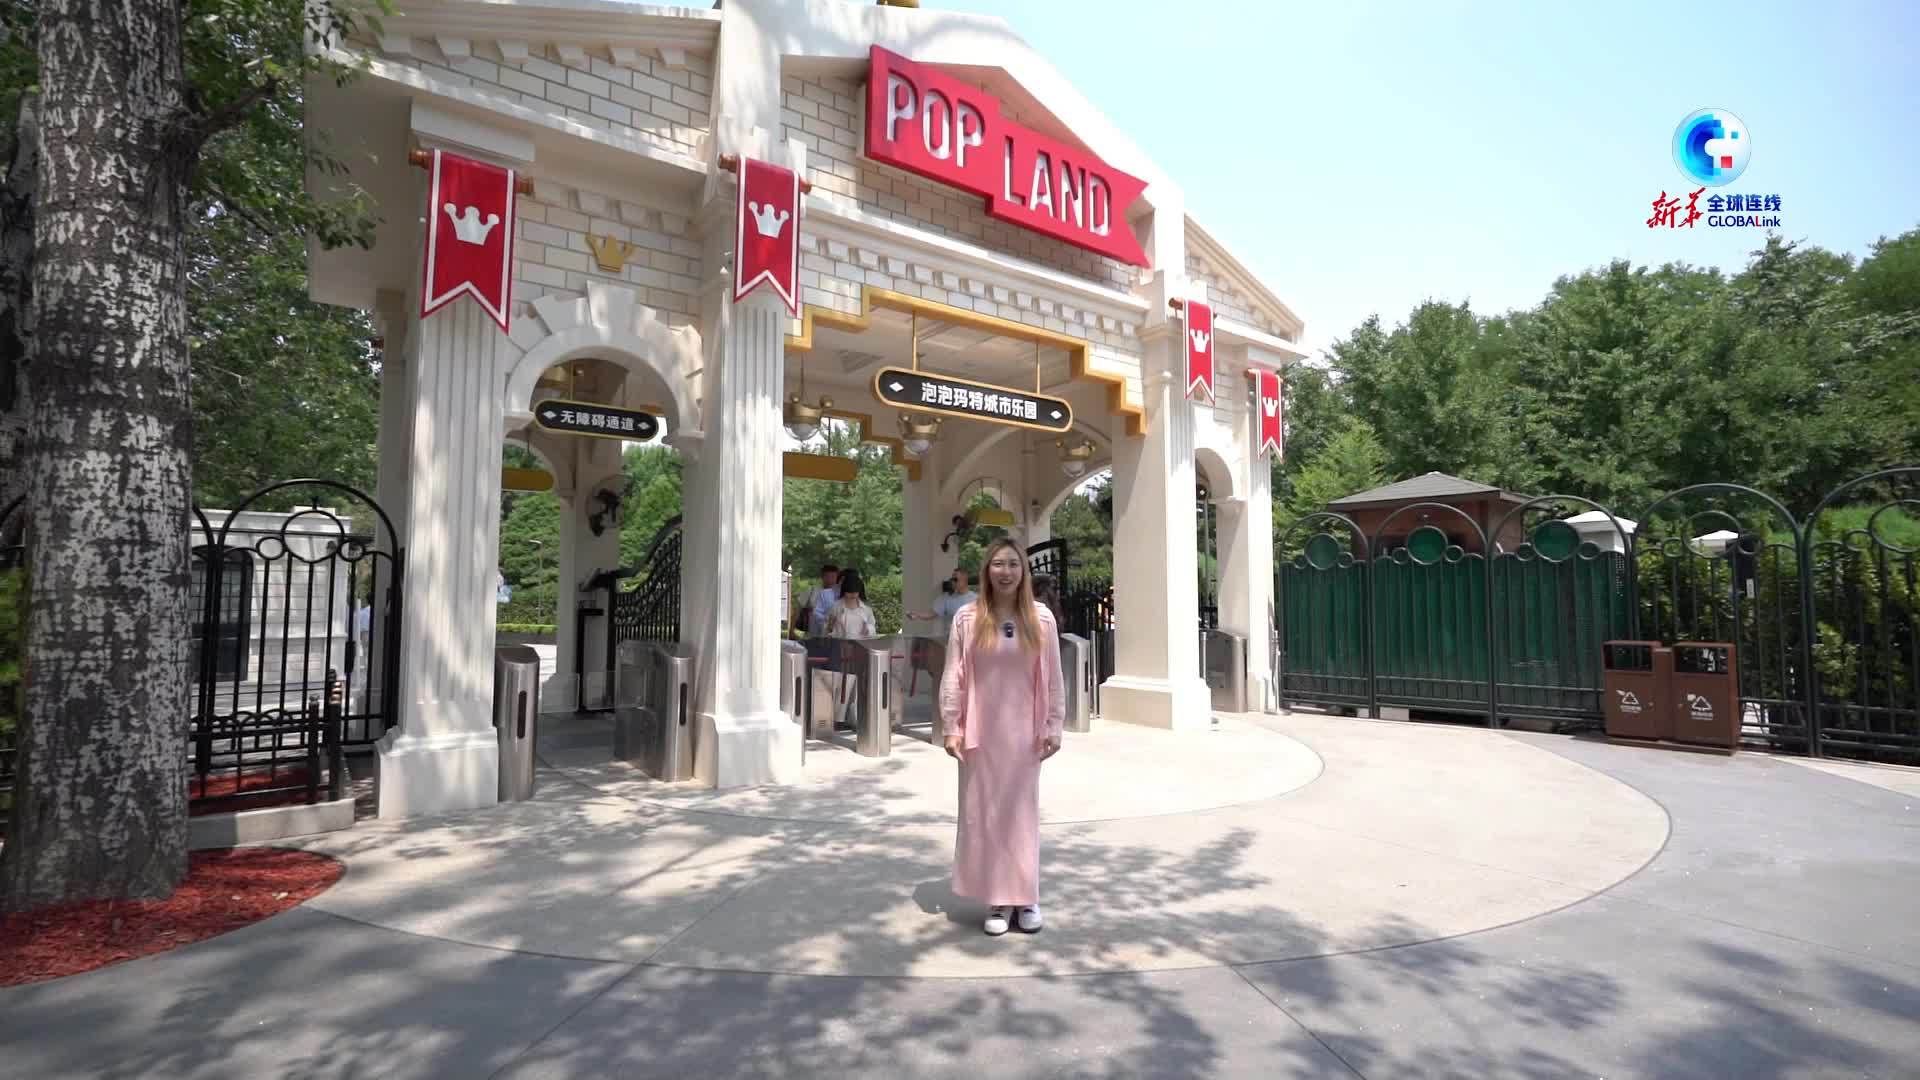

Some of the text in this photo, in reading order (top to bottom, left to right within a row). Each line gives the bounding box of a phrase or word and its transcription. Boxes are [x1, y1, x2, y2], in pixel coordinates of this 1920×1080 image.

[887, 69, 1112, 236] POP LAND
[921, 382, 1038, 420] 泡泡玛特城市乐园
[560, 410, 635, 431] 无障碍通道
